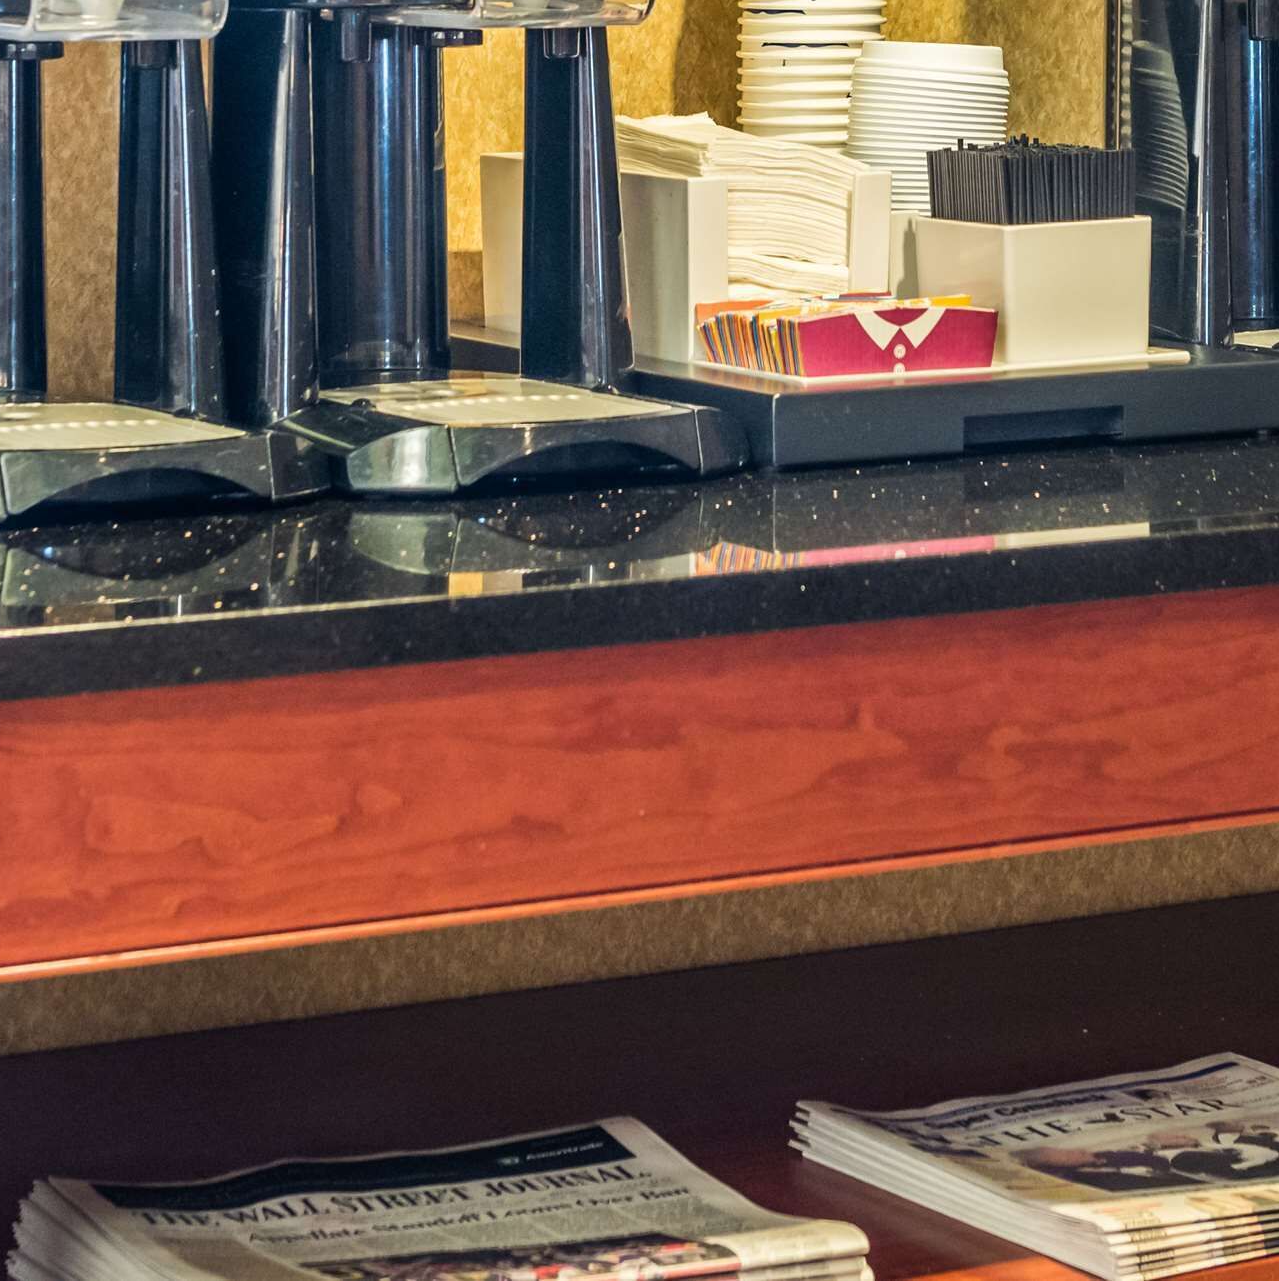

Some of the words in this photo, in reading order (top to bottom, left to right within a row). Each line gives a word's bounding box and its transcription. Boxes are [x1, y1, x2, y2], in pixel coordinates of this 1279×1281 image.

[978, 1119, 1082, 1147] THE
[1119, 1098, 1243, 1120] STAR
[131, 1209, 220, 1227] THE
[223, 1195, 332, 1225] WALL
[330, 1182, 473, 1216] STREET
